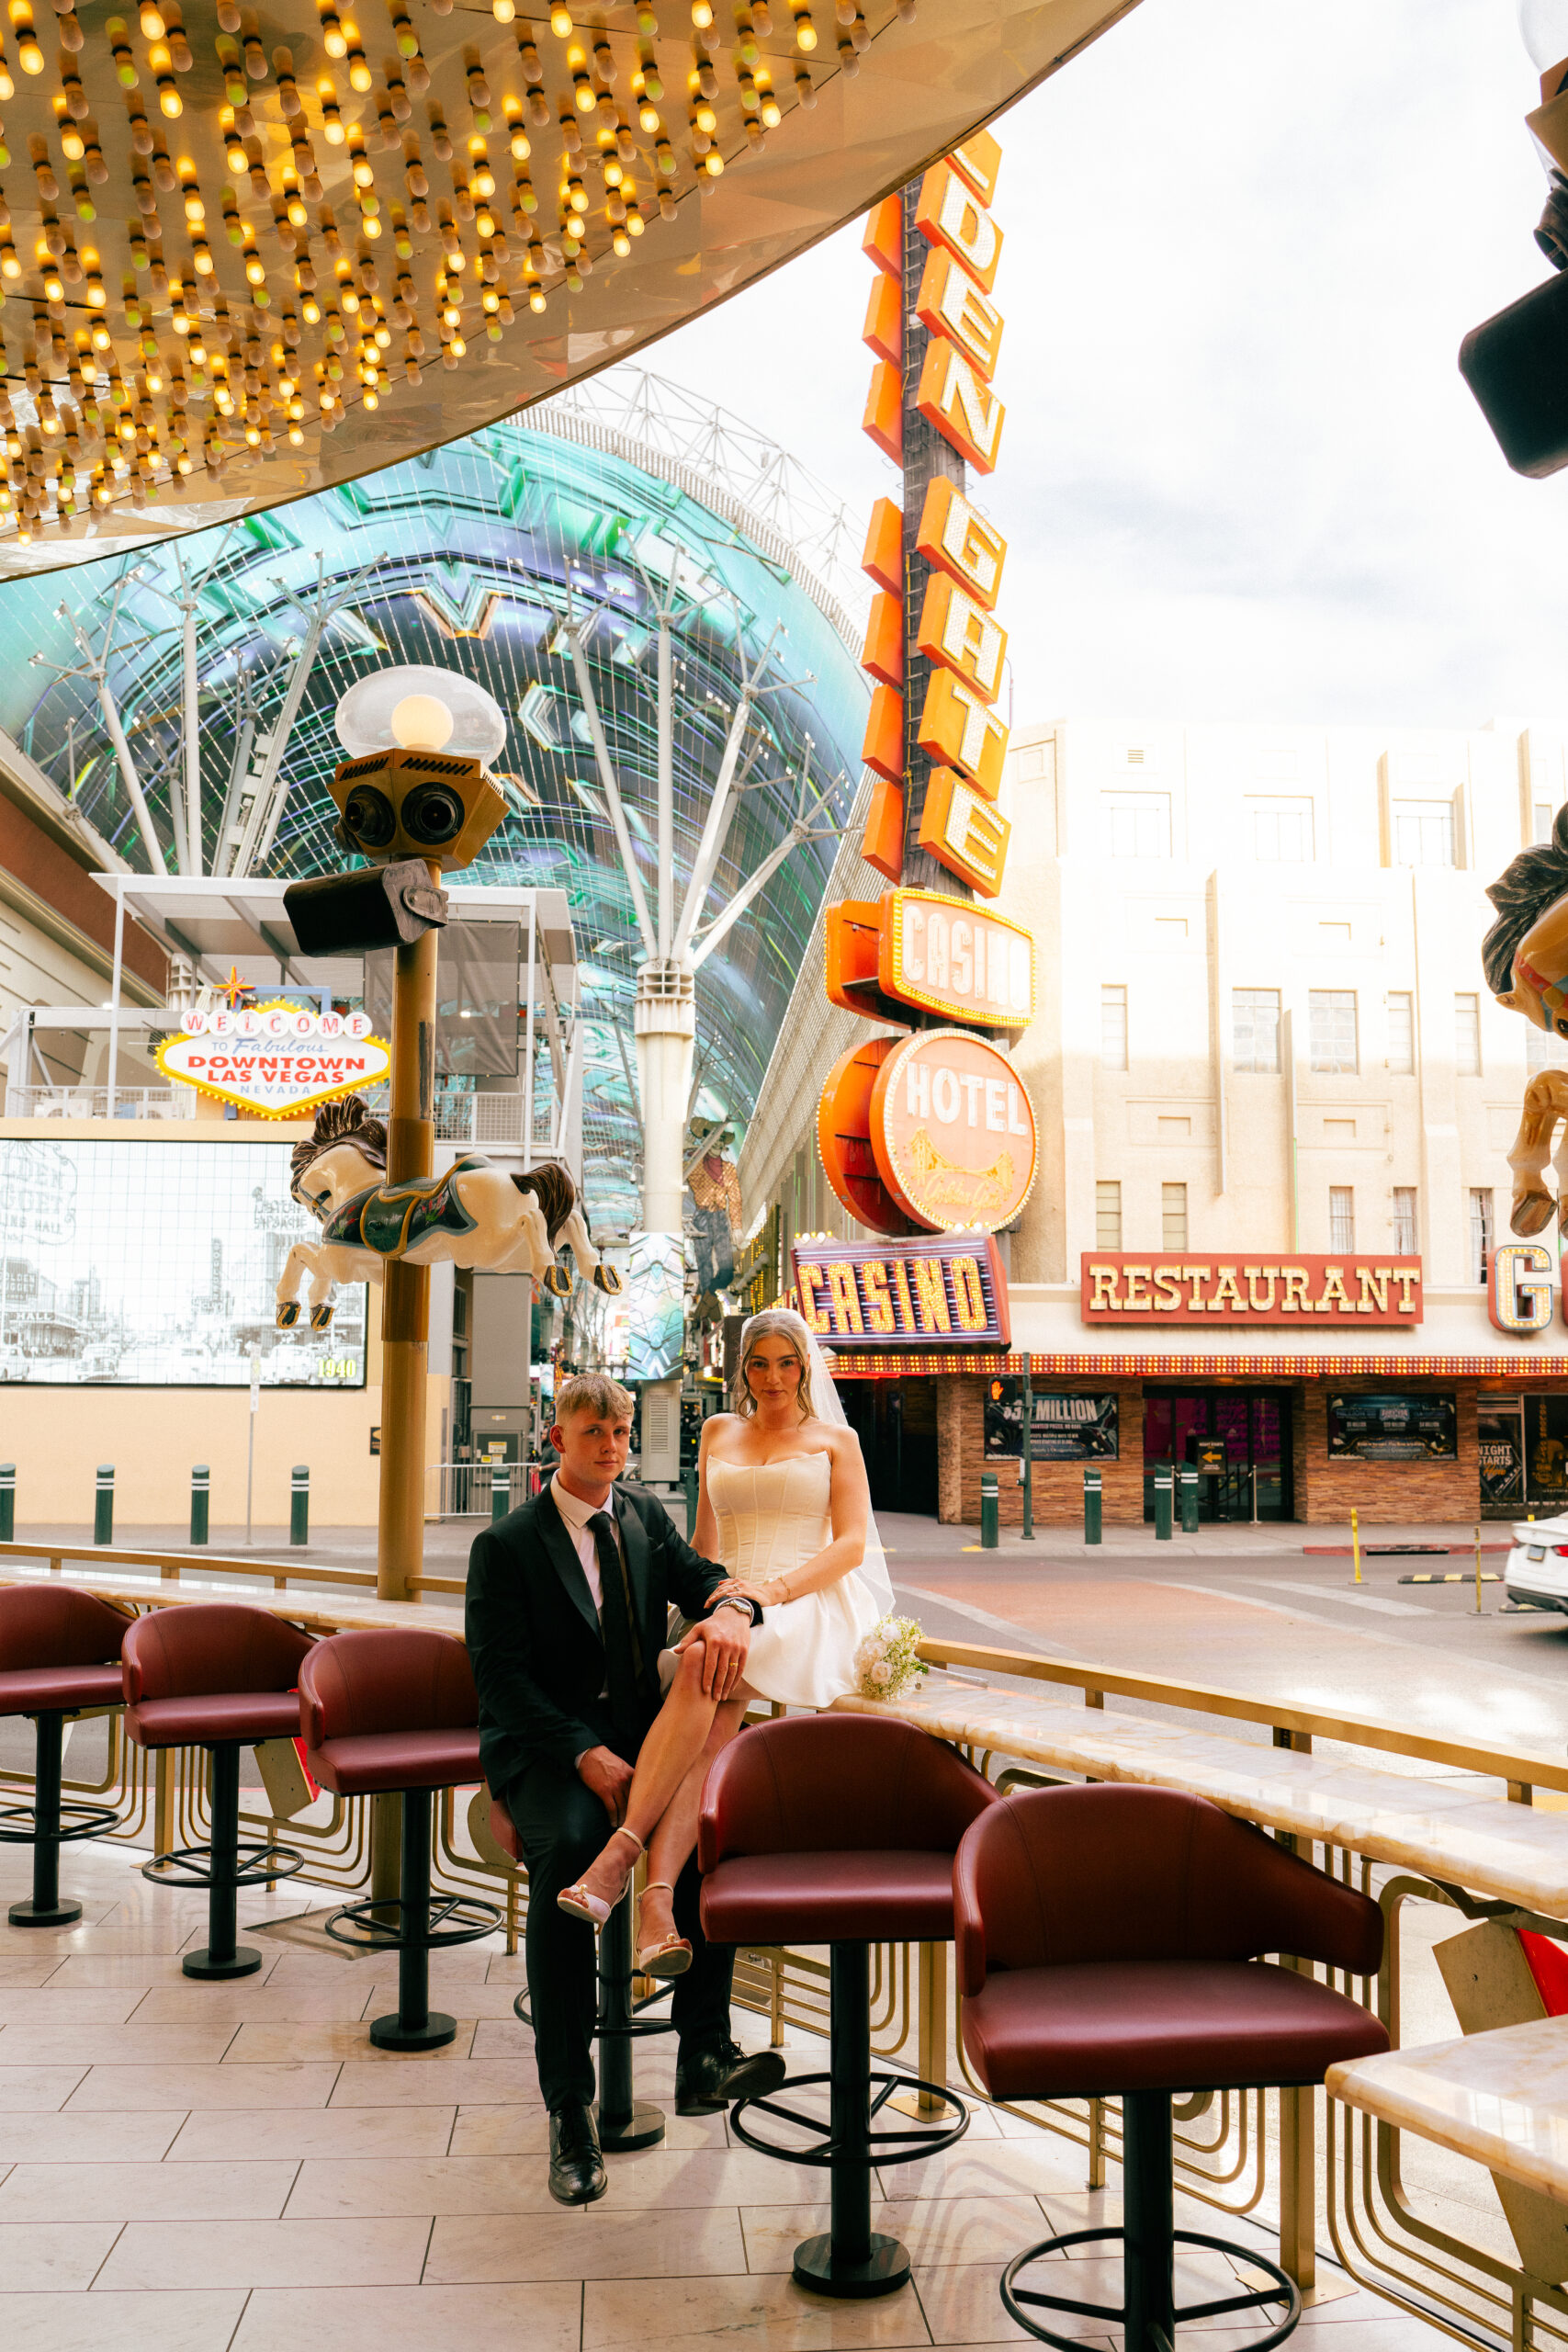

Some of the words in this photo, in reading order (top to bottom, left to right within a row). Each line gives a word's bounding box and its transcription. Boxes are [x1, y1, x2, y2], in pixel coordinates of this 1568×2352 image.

[942, 491, 1005, 881] GATE
[903, 905, 1031, 1011] CASINO
[186, 1013, 363, 1035] WELCOME
[212, 1042, 228, 1052] TO
[232, 1038, 329, 1055] Fabulous
[188, 1057, 365, 1070] DOWNTOWN
[208, 1070, 253, 1082] LAS
[263, 1070, 344, 1083] VEGAS
[240, 1085, 311, 1095] NEVADA
[907, 1062, 1029, 1136] HOTEL
[797, 1255, 987, 1335] CASINO
[1089, 1263, 1420, 1313] RESTAURANT
[1489, 1245, 1568, 1331] G
[318, 1359, 356, 1378] 1940
[1035, 1399, 1099, 1421] MILLION
[1478, 1445, 1512, 1456] NIGHT
